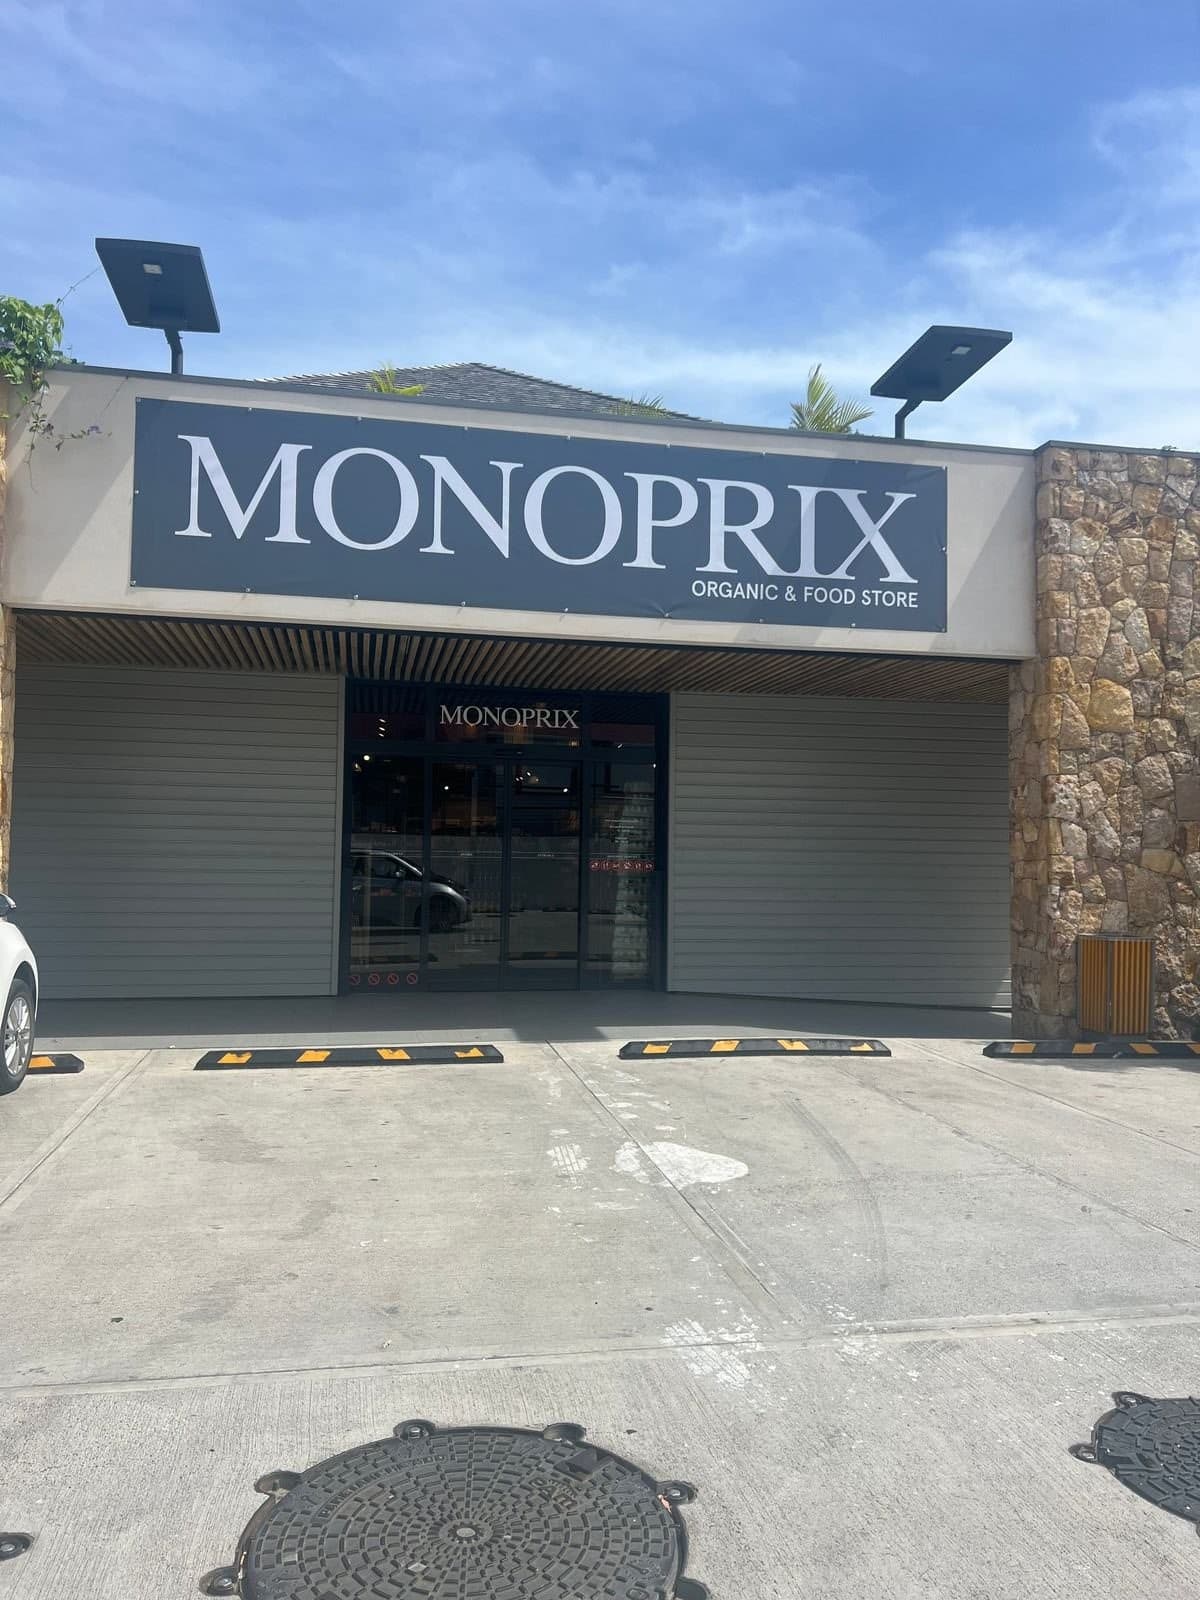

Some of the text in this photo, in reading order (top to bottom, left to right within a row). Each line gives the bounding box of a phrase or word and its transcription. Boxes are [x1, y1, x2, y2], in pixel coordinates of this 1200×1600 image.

[174, 434, 919, 585] MONOPRIX
[691, 580, 919, 608] ORGANIC & FOOD STORE
[439, 704, 579, 729] MONOPRIX
